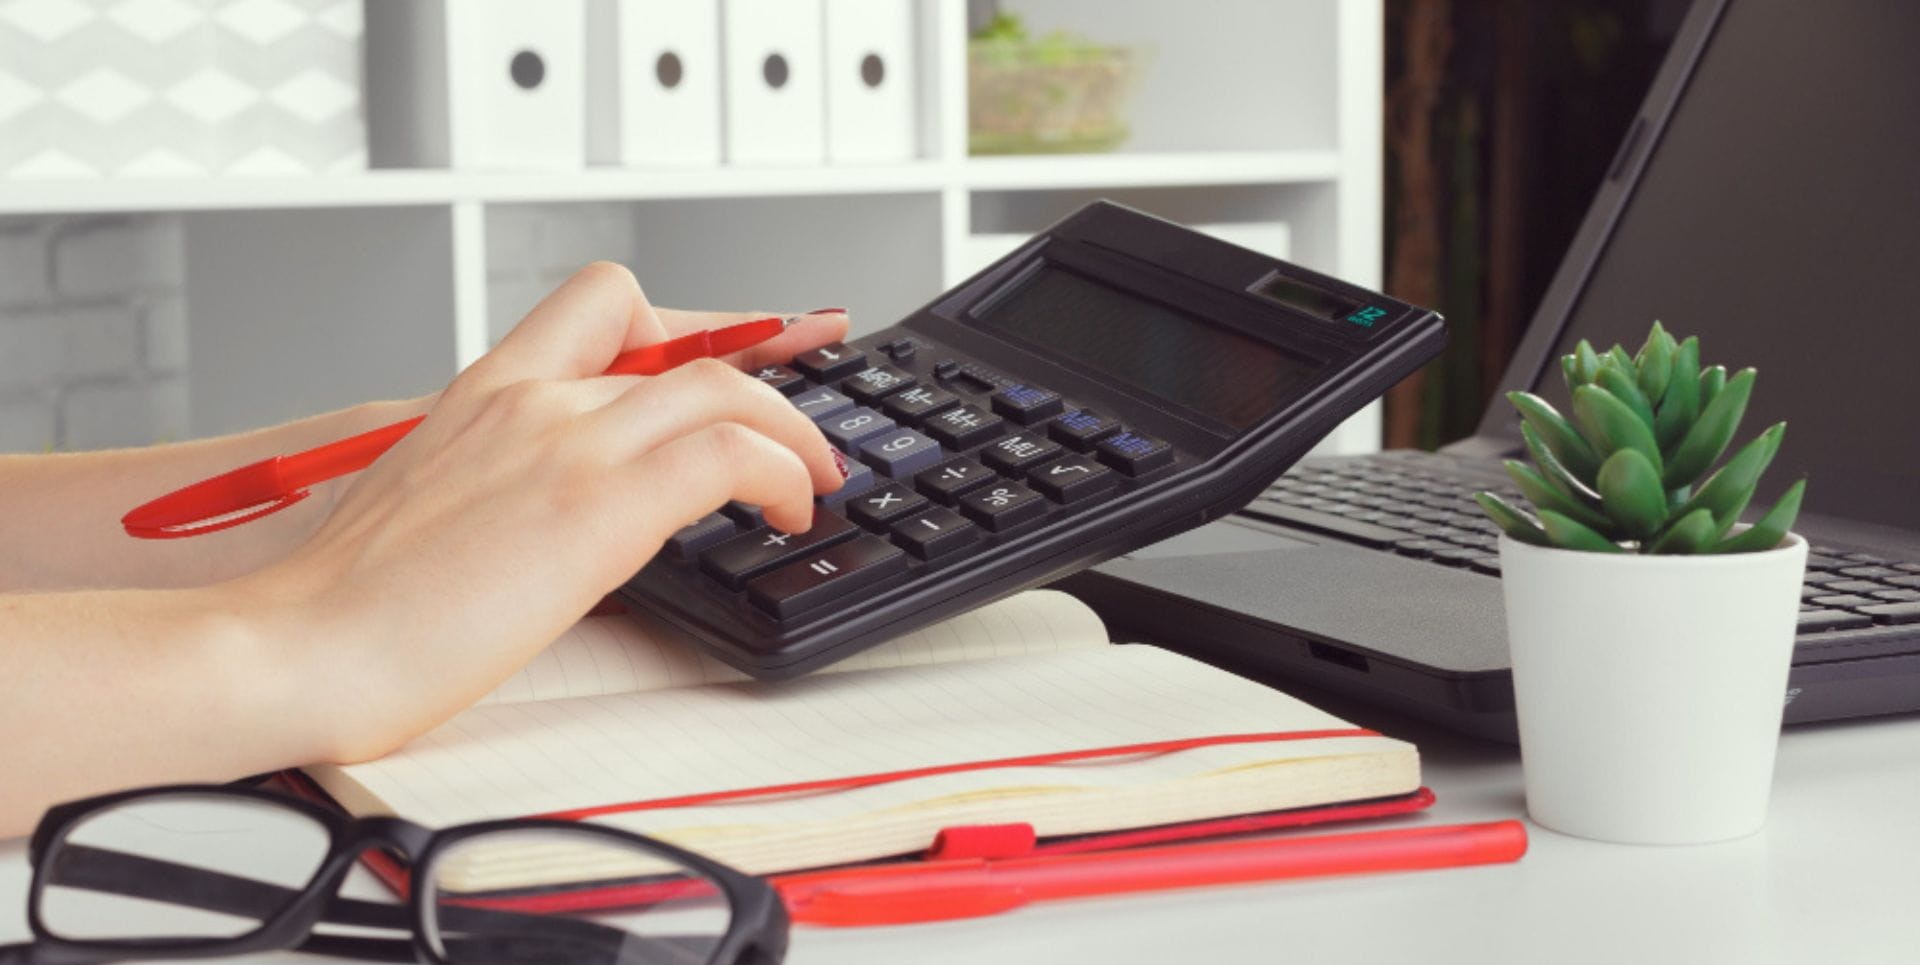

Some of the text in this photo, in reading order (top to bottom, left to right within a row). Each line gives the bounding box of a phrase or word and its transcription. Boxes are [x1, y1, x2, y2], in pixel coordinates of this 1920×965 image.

[799, 393, 834, 408] 7
[839, 414, 873, 431] 8
[881, 436, 916, 453] 9
[997, 436, 1045, 458] MU
